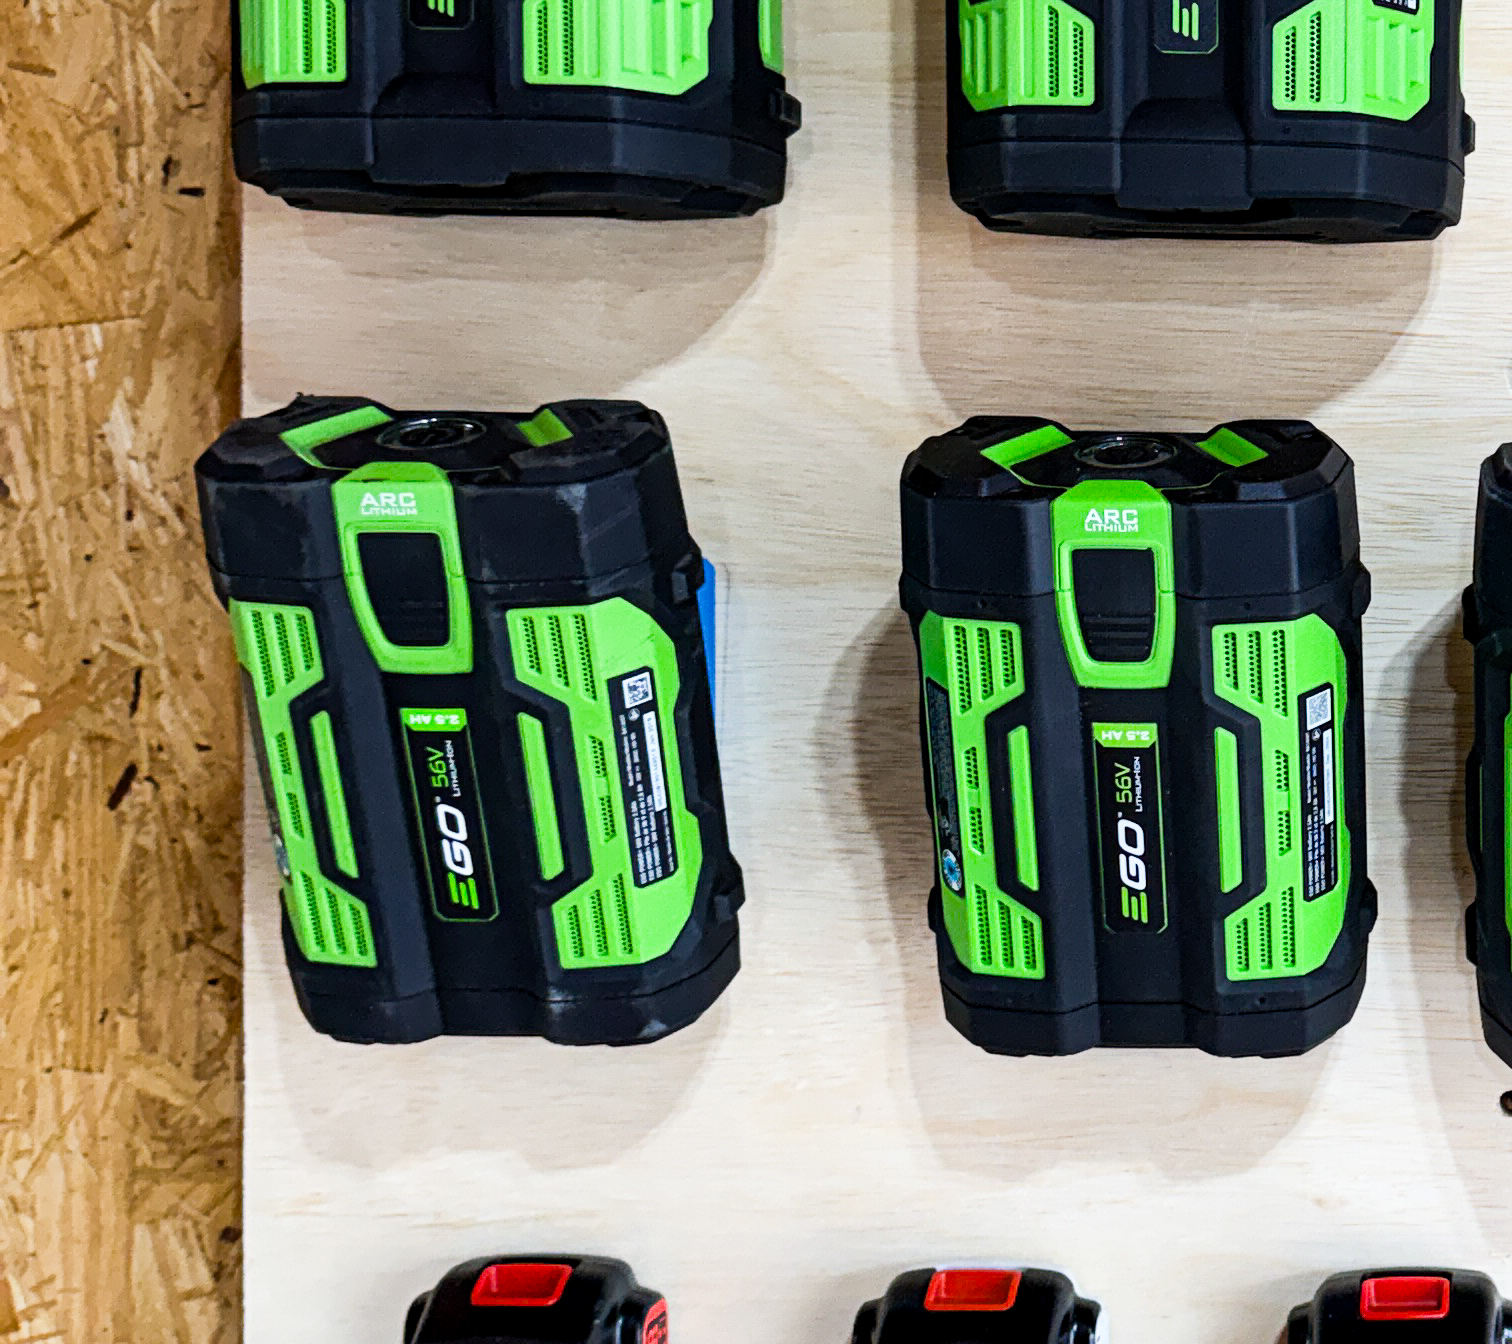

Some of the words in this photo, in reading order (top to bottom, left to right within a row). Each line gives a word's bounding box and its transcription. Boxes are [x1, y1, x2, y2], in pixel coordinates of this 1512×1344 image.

[360, 492, 416, 507] ARC
[361, 507, 418, 516] LITHIUM
[1085, 508, 1138, 524] ARC
[1085, 523, 1138, 532] LITHIUM
[1101, 730, 1123, 741] AH
[425, 746, 449, 788] 56V
[1114, 762, 1133, 803] 56V
